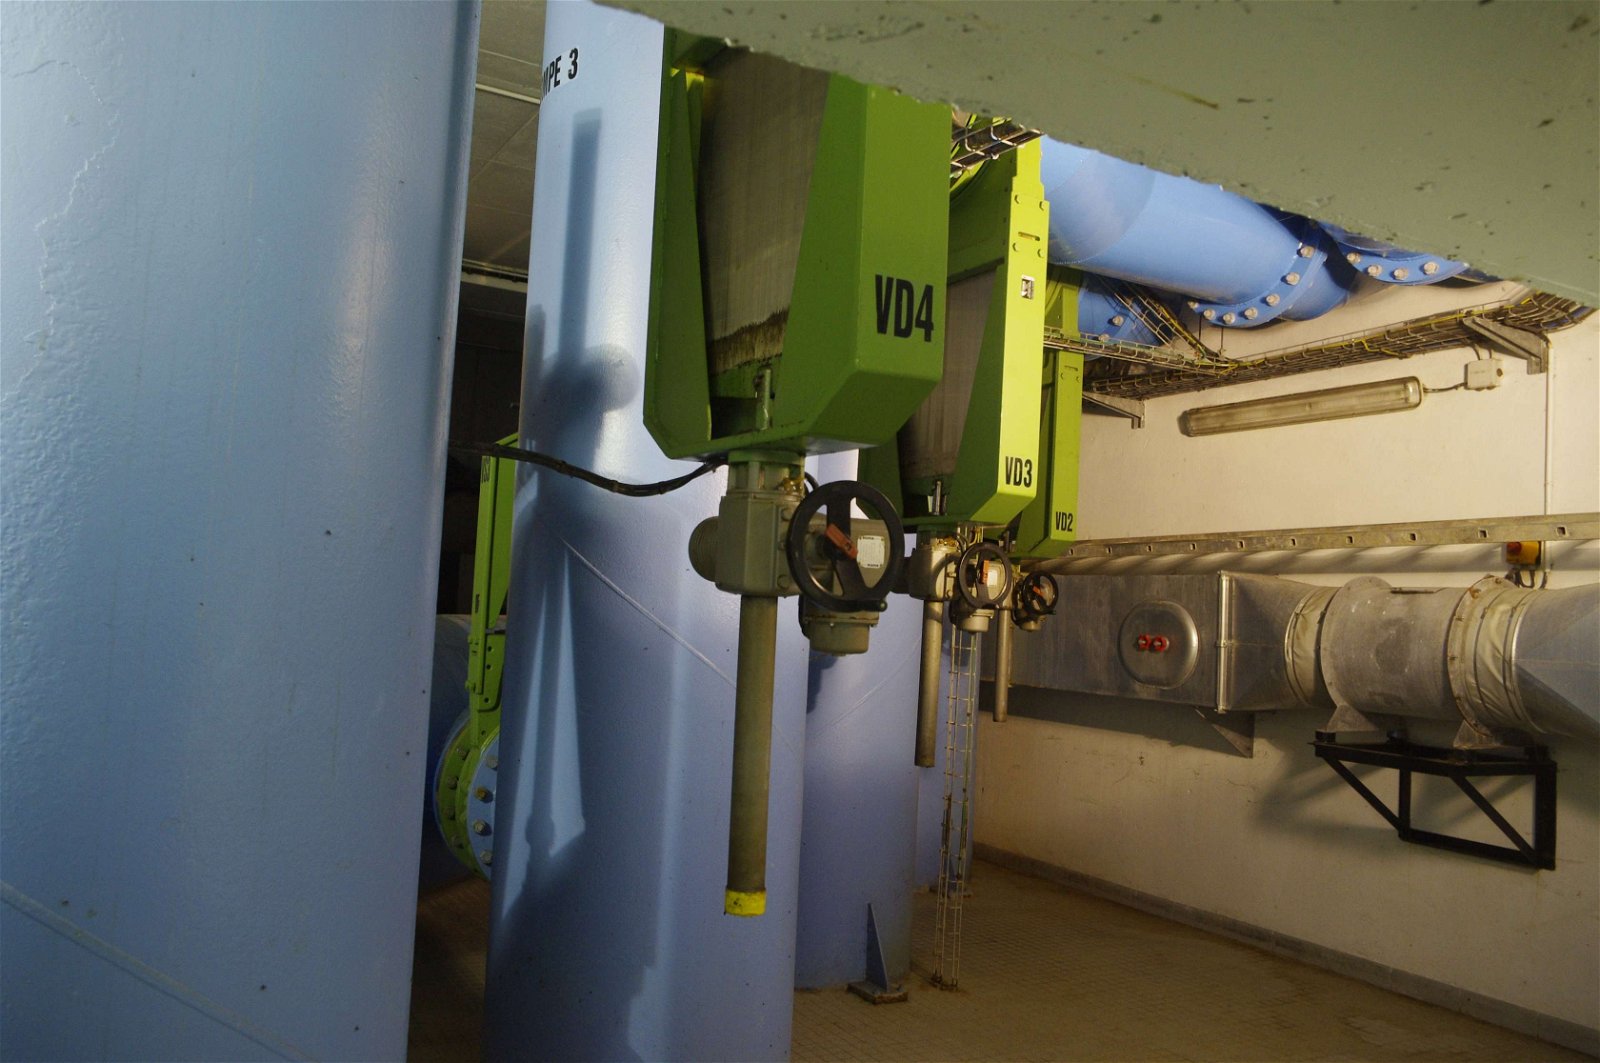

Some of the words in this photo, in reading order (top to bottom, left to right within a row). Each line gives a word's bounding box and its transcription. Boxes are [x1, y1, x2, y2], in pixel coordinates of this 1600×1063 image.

[568, 47, 579, 80] 3
[875, 274, 934, 342] VD4
[1005, 456, 1033, 488] VD3
[1055, 511, 1074, 532] VD2
